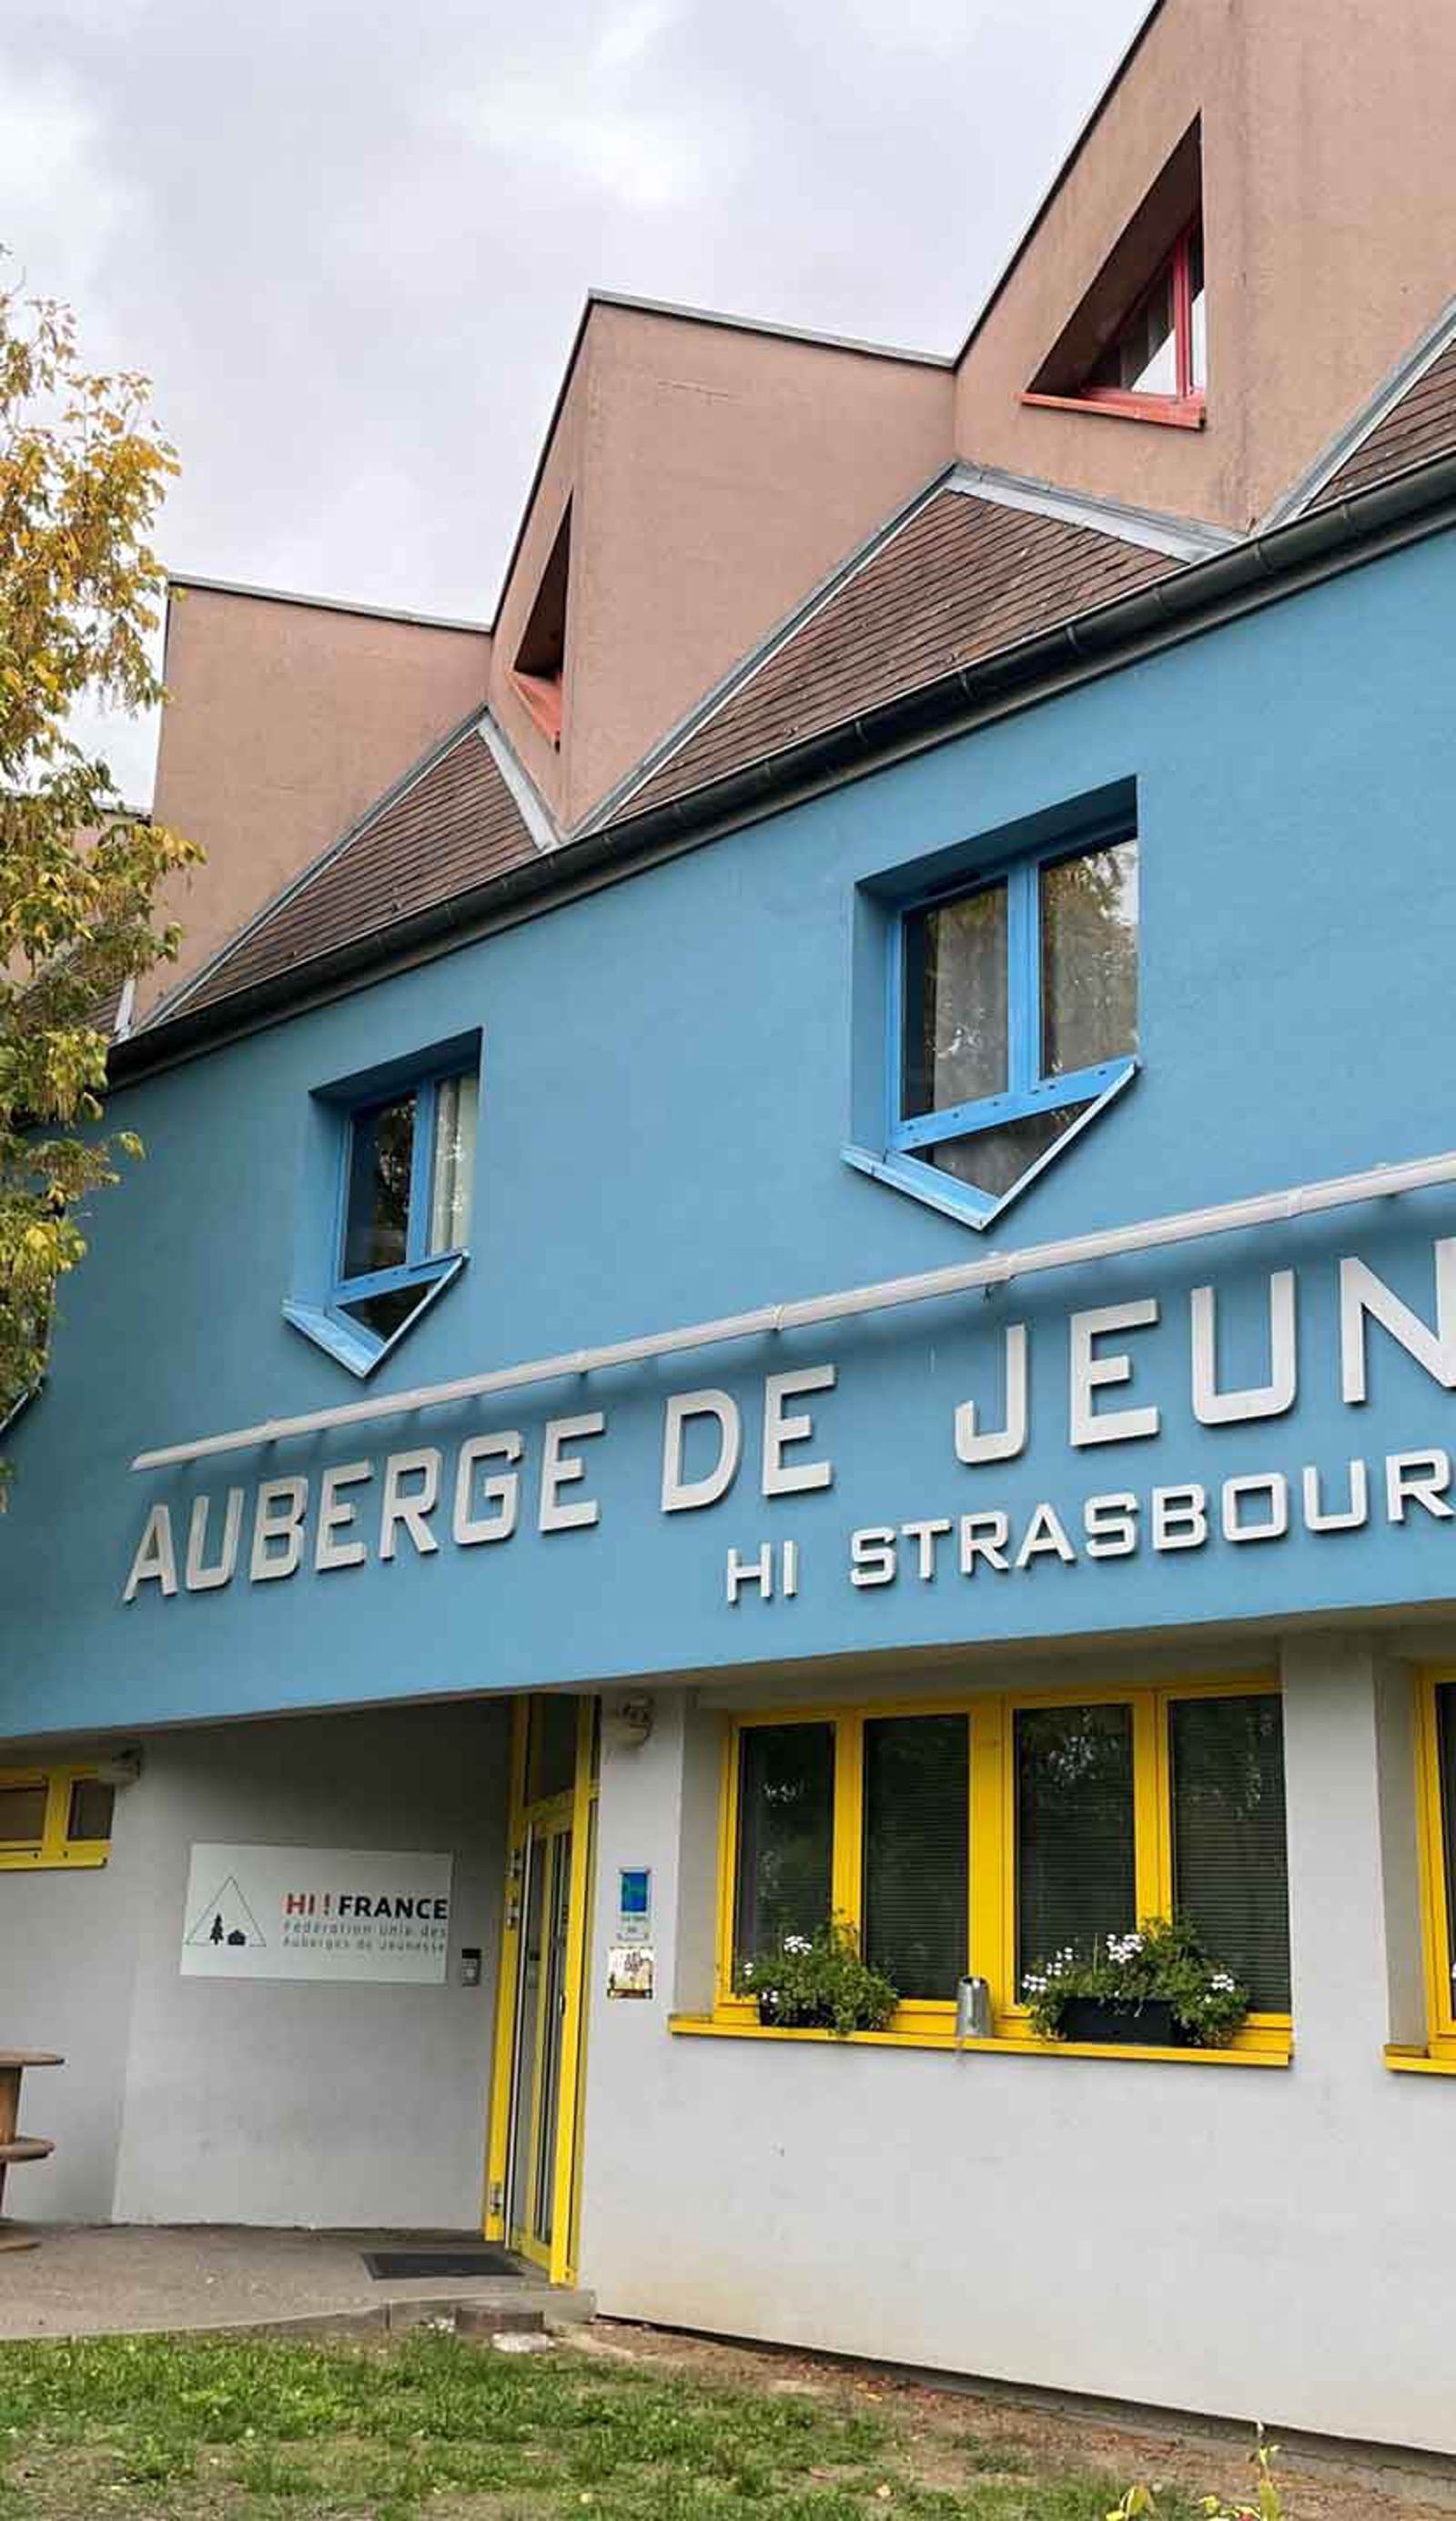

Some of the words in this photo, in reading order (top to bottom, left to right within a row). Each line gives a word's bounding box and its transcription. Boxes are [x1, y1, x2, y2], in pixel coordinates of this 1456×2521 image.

[123, 1412, 606, 1603] AUBERGE
[662, 1363, 836, 1513] DE
[955, 1238, 1456, 1464] JEUN
[727, 1540, 799, 1602] HI
[850, 1449, 1456, 1586] STRASBOUR
[338, 1896, 448, 1919] FRANCE
